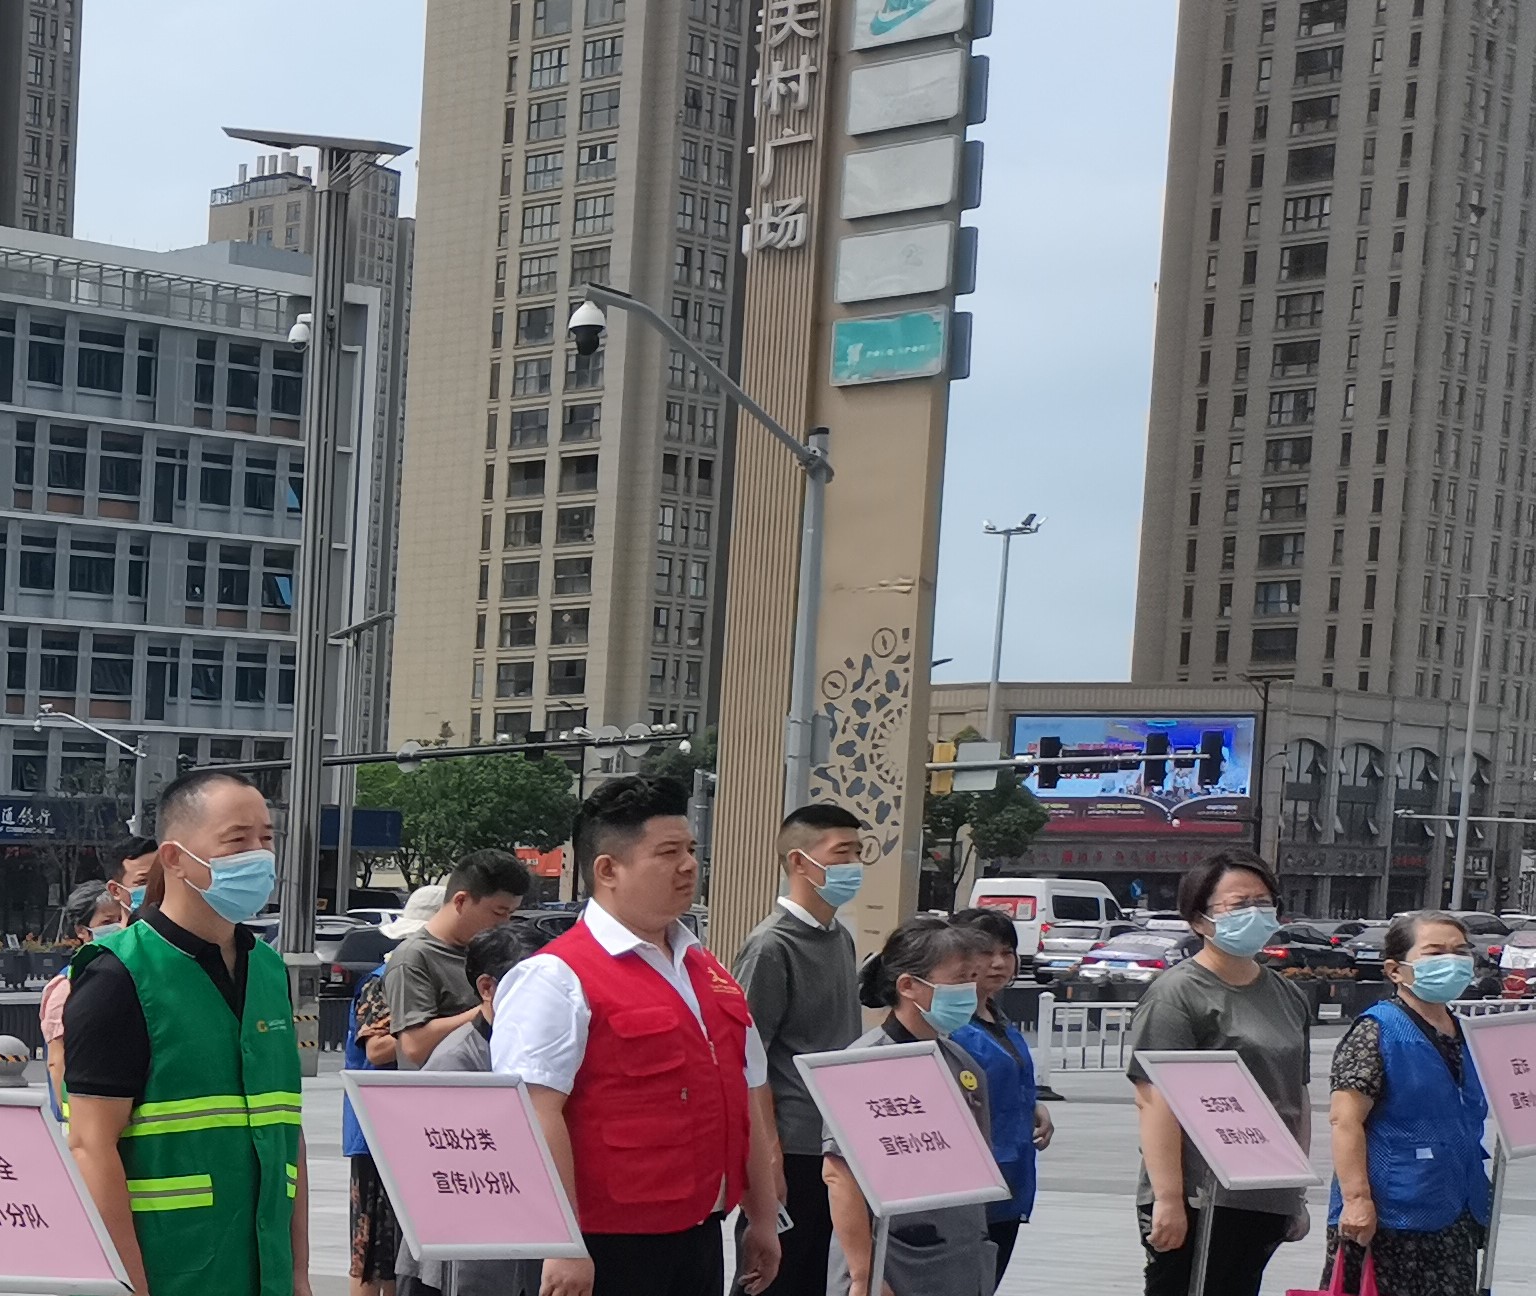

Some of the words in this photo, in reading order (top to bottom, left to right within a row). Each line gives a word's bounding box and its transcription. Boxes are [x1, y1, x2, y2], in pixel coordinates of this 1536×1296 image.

[865, 1094, 926, 1119] 交通安全
[424, 1127, 497, 1151] 垃圾分类
[878, 1130, 951, 1156] 宣传小分队
[432, 1171, 521, 1196] 宣传小分队
